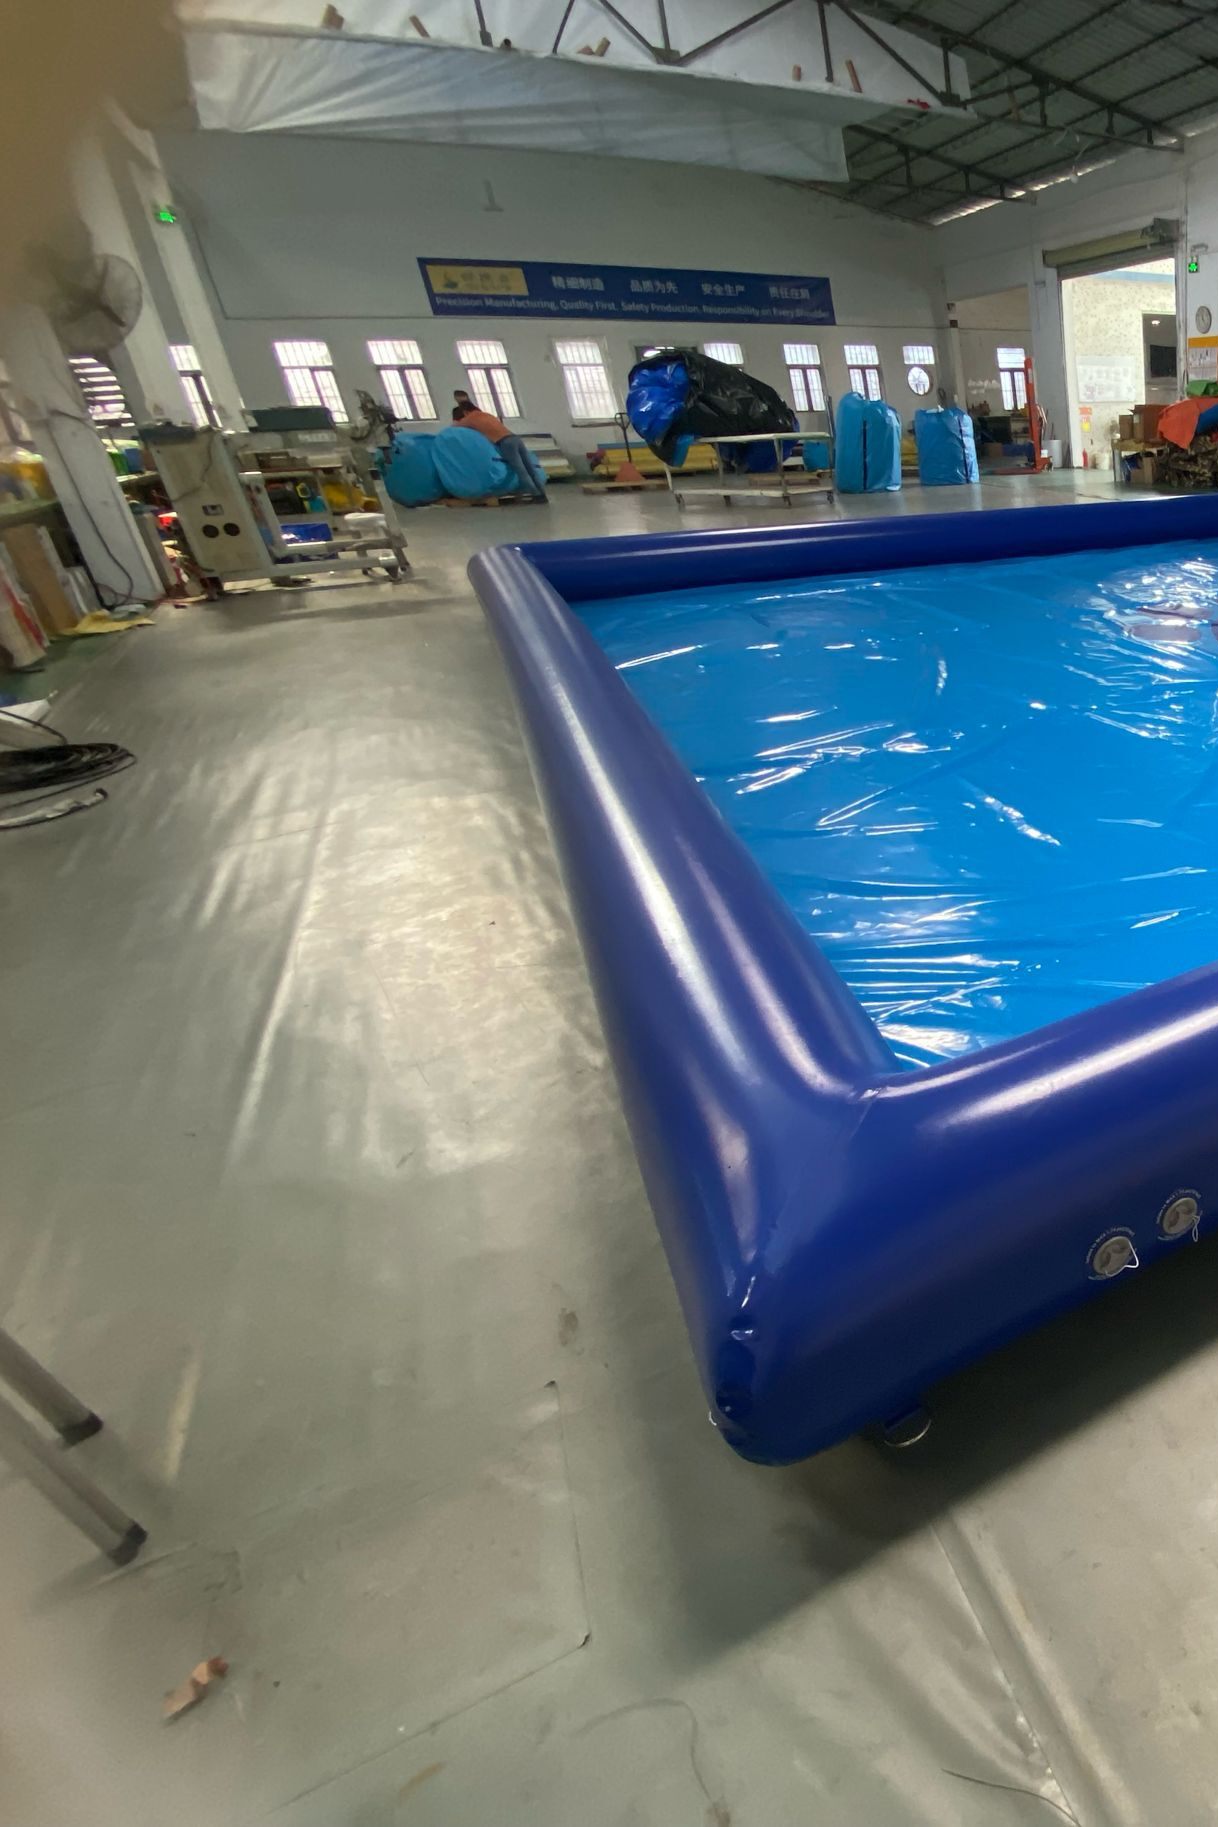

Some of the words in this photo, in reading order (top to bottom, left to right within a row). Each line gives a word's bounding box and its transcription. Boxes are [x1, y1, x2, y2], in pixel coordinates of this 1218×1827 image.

[630, 279, 678, 294] 品质为先
[701, 283, 745, 297] 安全生产
[435, 296, 481, 307] Precision
[484, 297, 559, 312] Manufacturing,
[560, 299, 593, 312] Quality
[621, 300, 649, 313] Safety
[772, 306, 794, 319] Every
